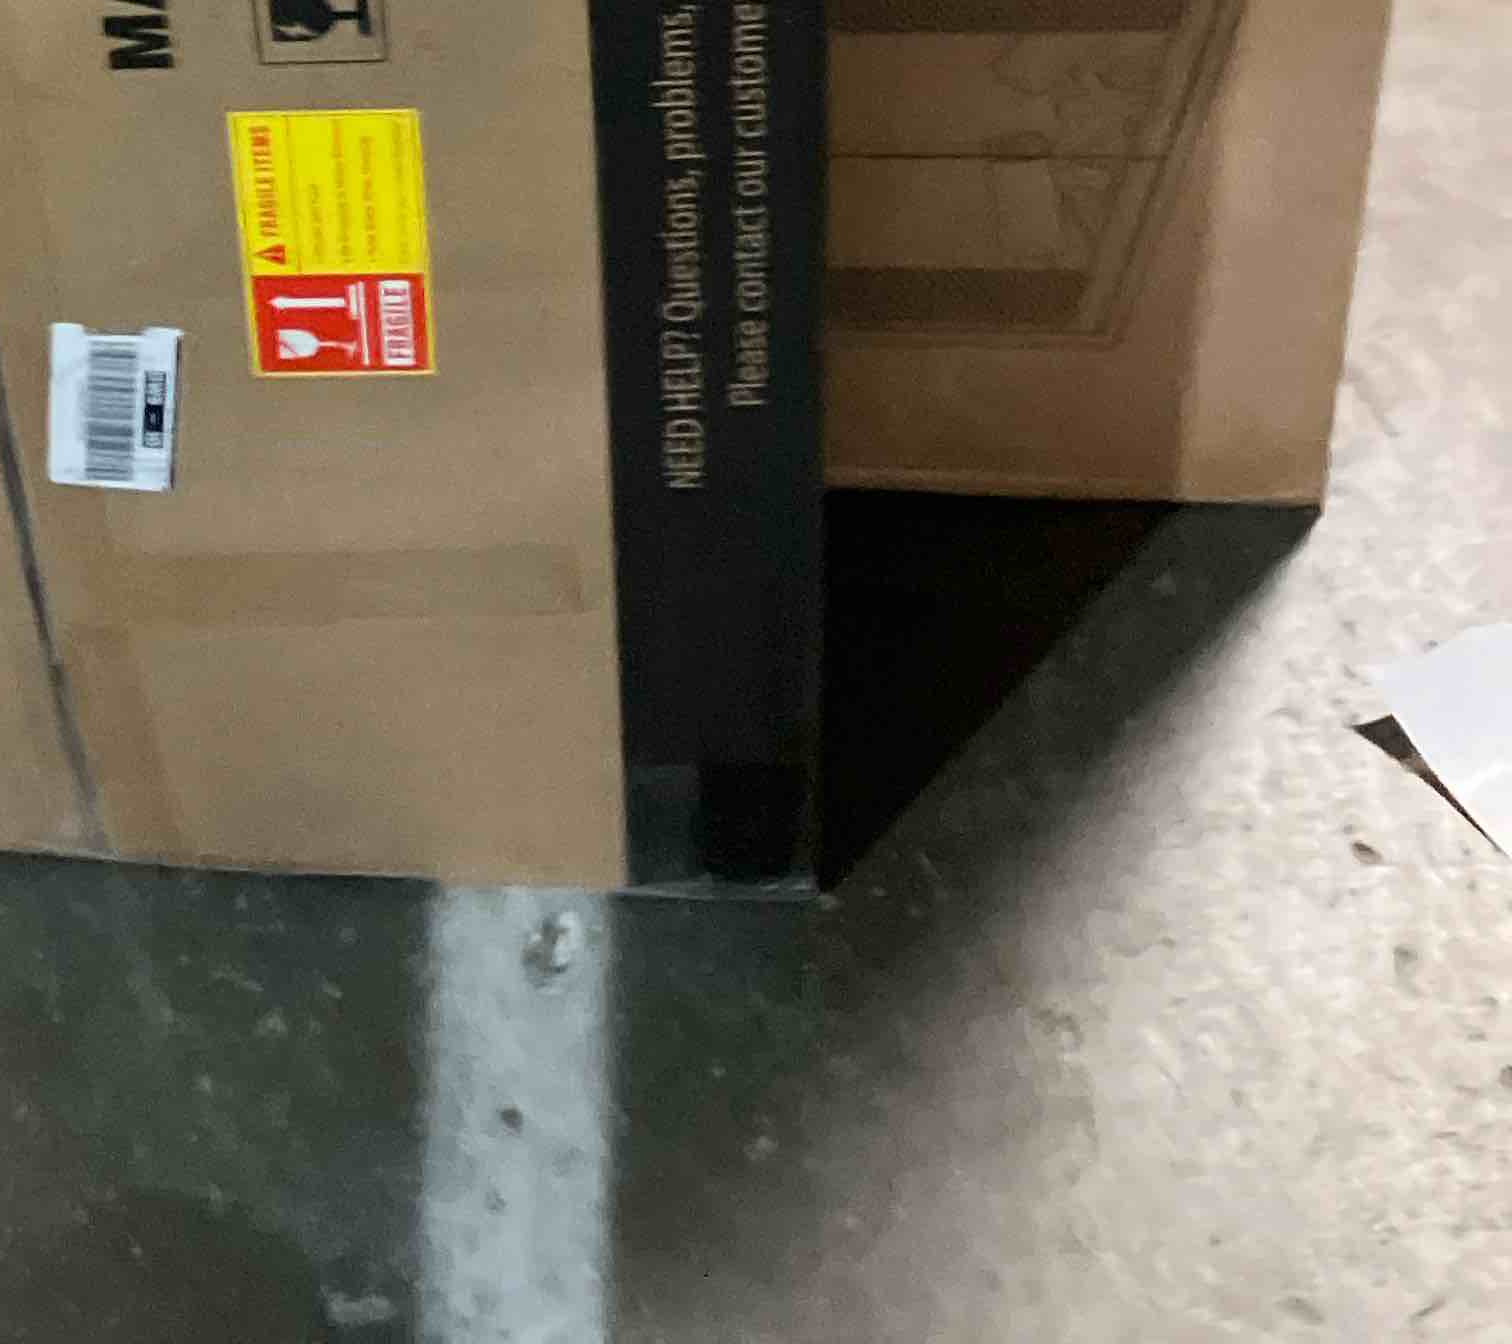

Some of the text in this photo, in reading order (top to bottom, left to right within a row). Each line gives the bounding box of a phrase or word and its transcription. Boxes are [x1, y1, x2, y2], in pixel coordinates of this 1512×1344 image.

[648, 2, 707, 160] problems,
[248, 125, 280, 239] FRAGILE ITEMS
[734, 150, 769, 197] our
[655, 168, 705, 322] Questions,
[731, 206, 770, 314] contact
[382, 287, 413, 360] FRAGILE
[726, 317, 770, 408] Please
[661, 328, 705, 412] HELP?
[662, 416, 706, 490] NEED
